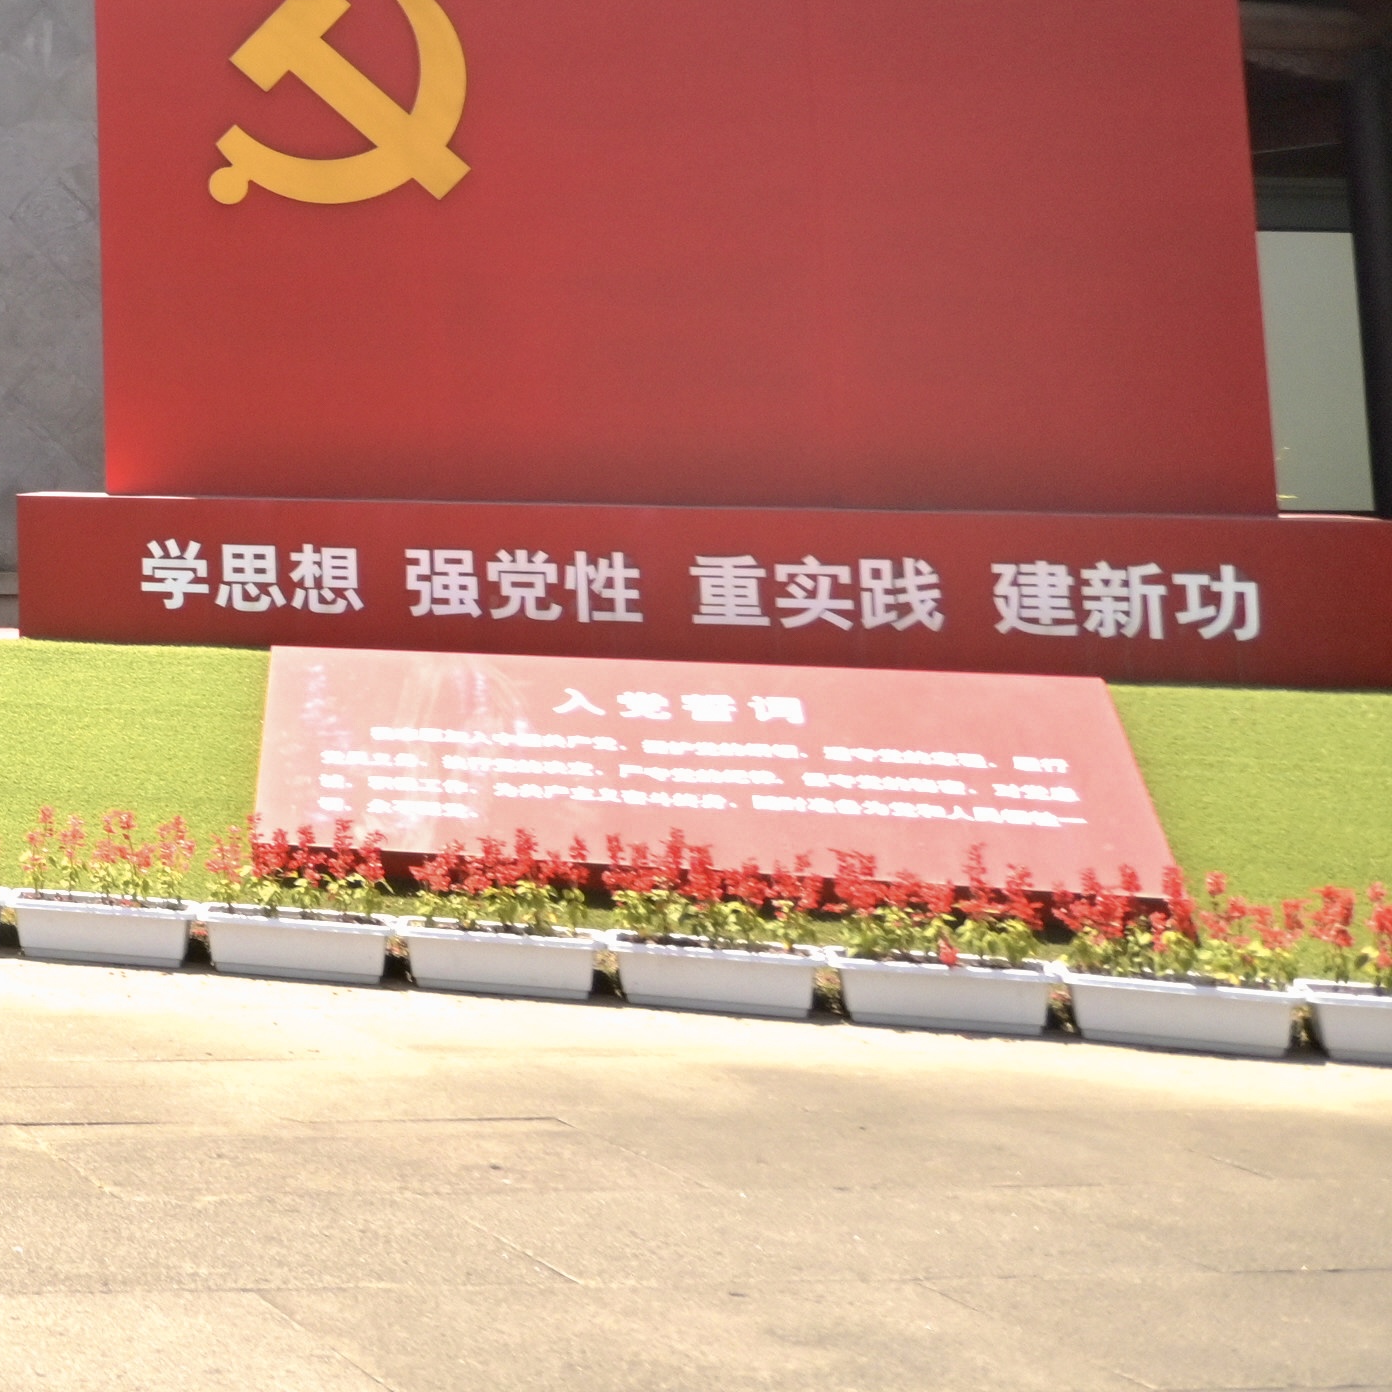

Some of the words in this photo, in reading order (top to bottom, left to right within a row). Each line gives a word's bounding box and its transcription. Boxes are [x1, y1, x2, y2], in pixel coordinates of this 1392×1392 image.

[141, 538, 364, 614] 学思想
[404, 547, 643, 624] 强党性
[689, 555, 943, 631] 重实践
[990, 560, 1260, 641] 建新功
